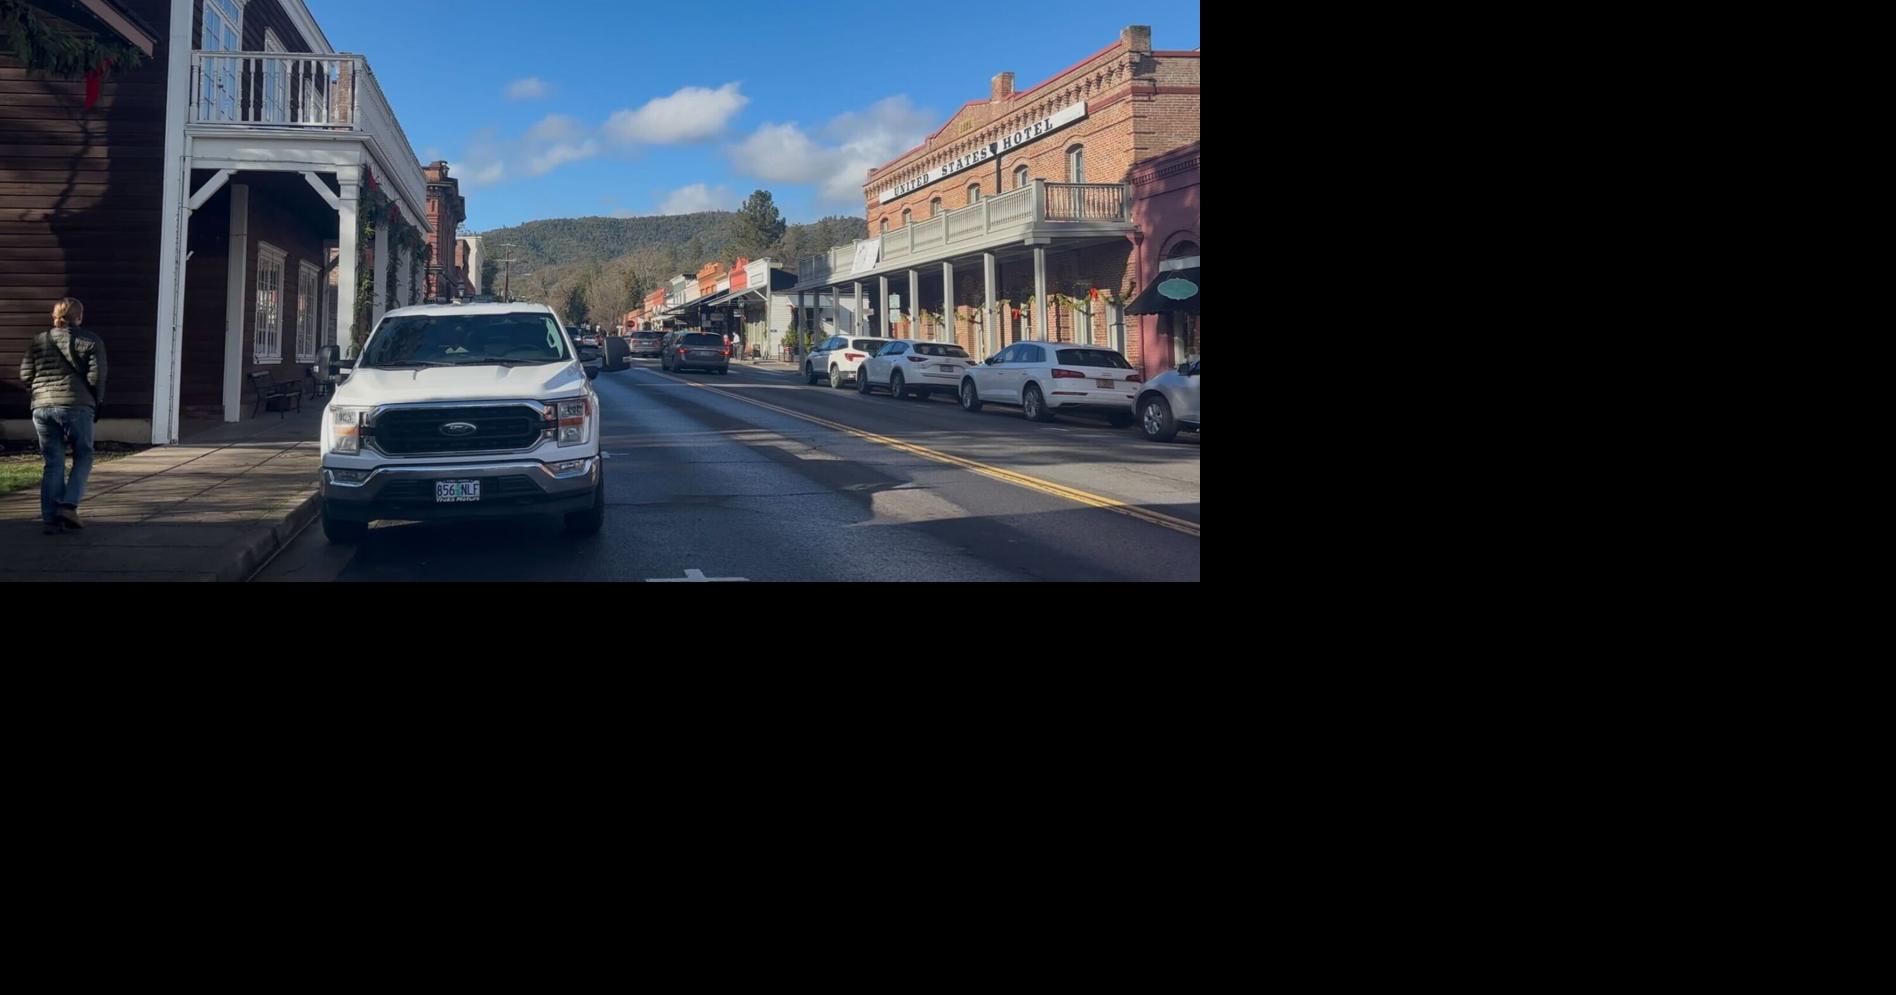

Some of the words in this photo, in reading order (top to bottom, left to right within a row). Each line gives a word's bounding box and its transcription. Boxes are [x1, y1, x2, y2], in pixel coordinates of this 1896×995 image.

[894, 173, 929, 196] UNITED
[941, 147, 987, 176] STATES
[1003, 117, 1053, 149] HOTEL
[461, 483, 480, 496] NLF
